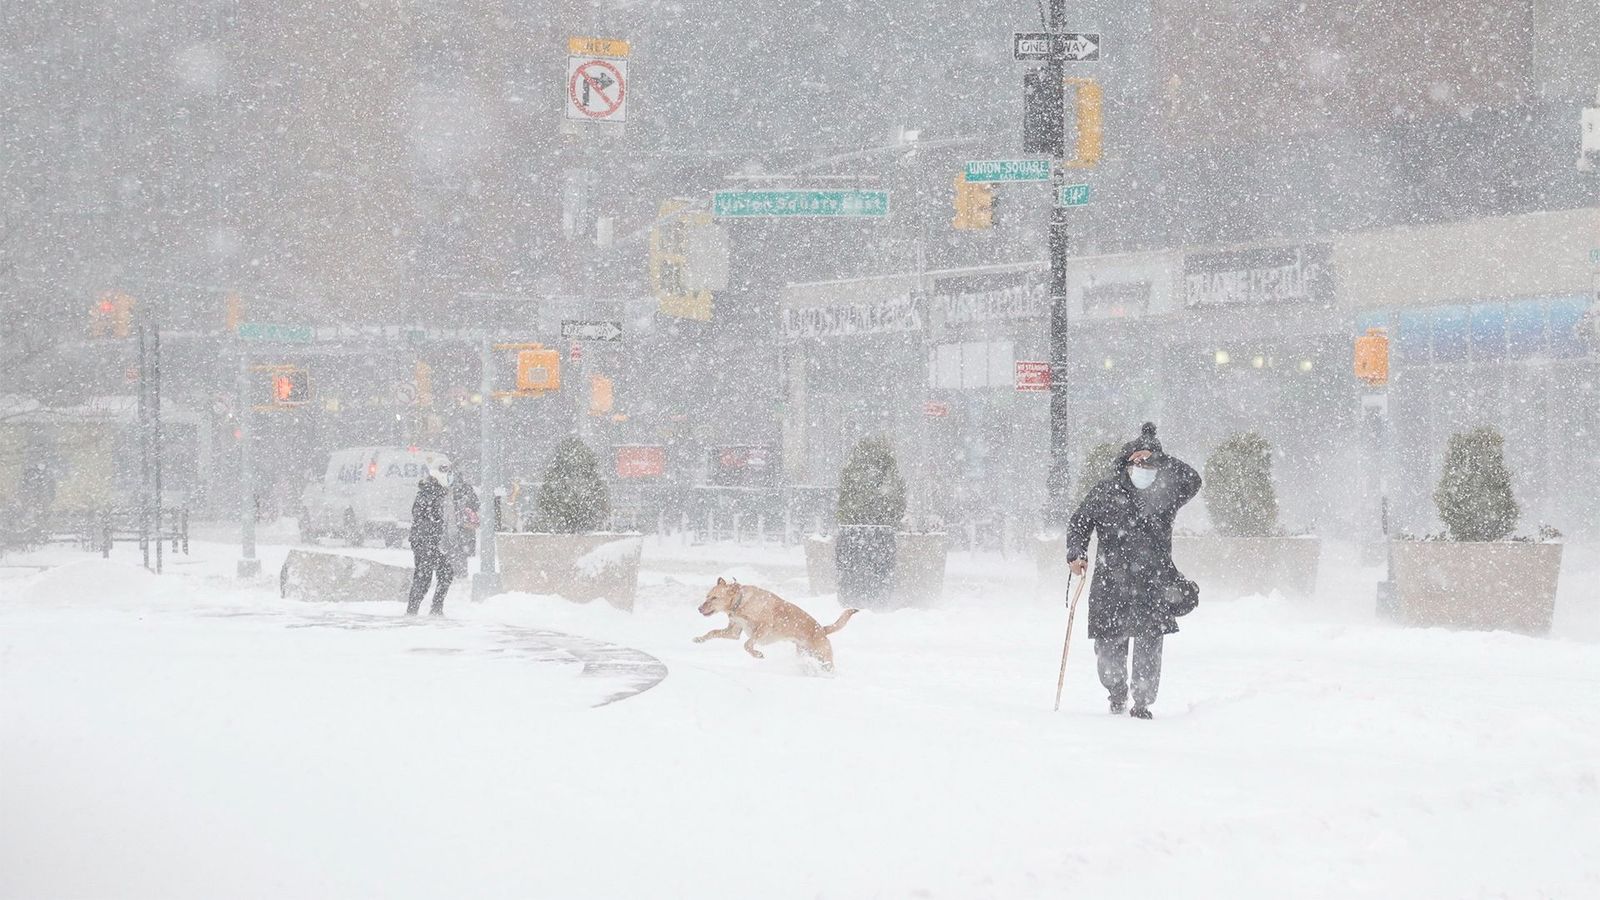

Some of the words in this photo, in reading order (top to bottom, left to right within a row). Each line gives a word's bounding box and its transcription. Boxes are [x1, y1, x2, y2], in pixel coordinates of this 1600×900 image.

[1021, 41, 1047, 52] ONE
[1062, 41, 1088, 53] WAY
[969, 161, 1001, 175] UNION
[1004, 160, 1047, 174] SQUARE
[775, 198, 839, 212] Square
[1185, 270, 1248, 306] DUANE
